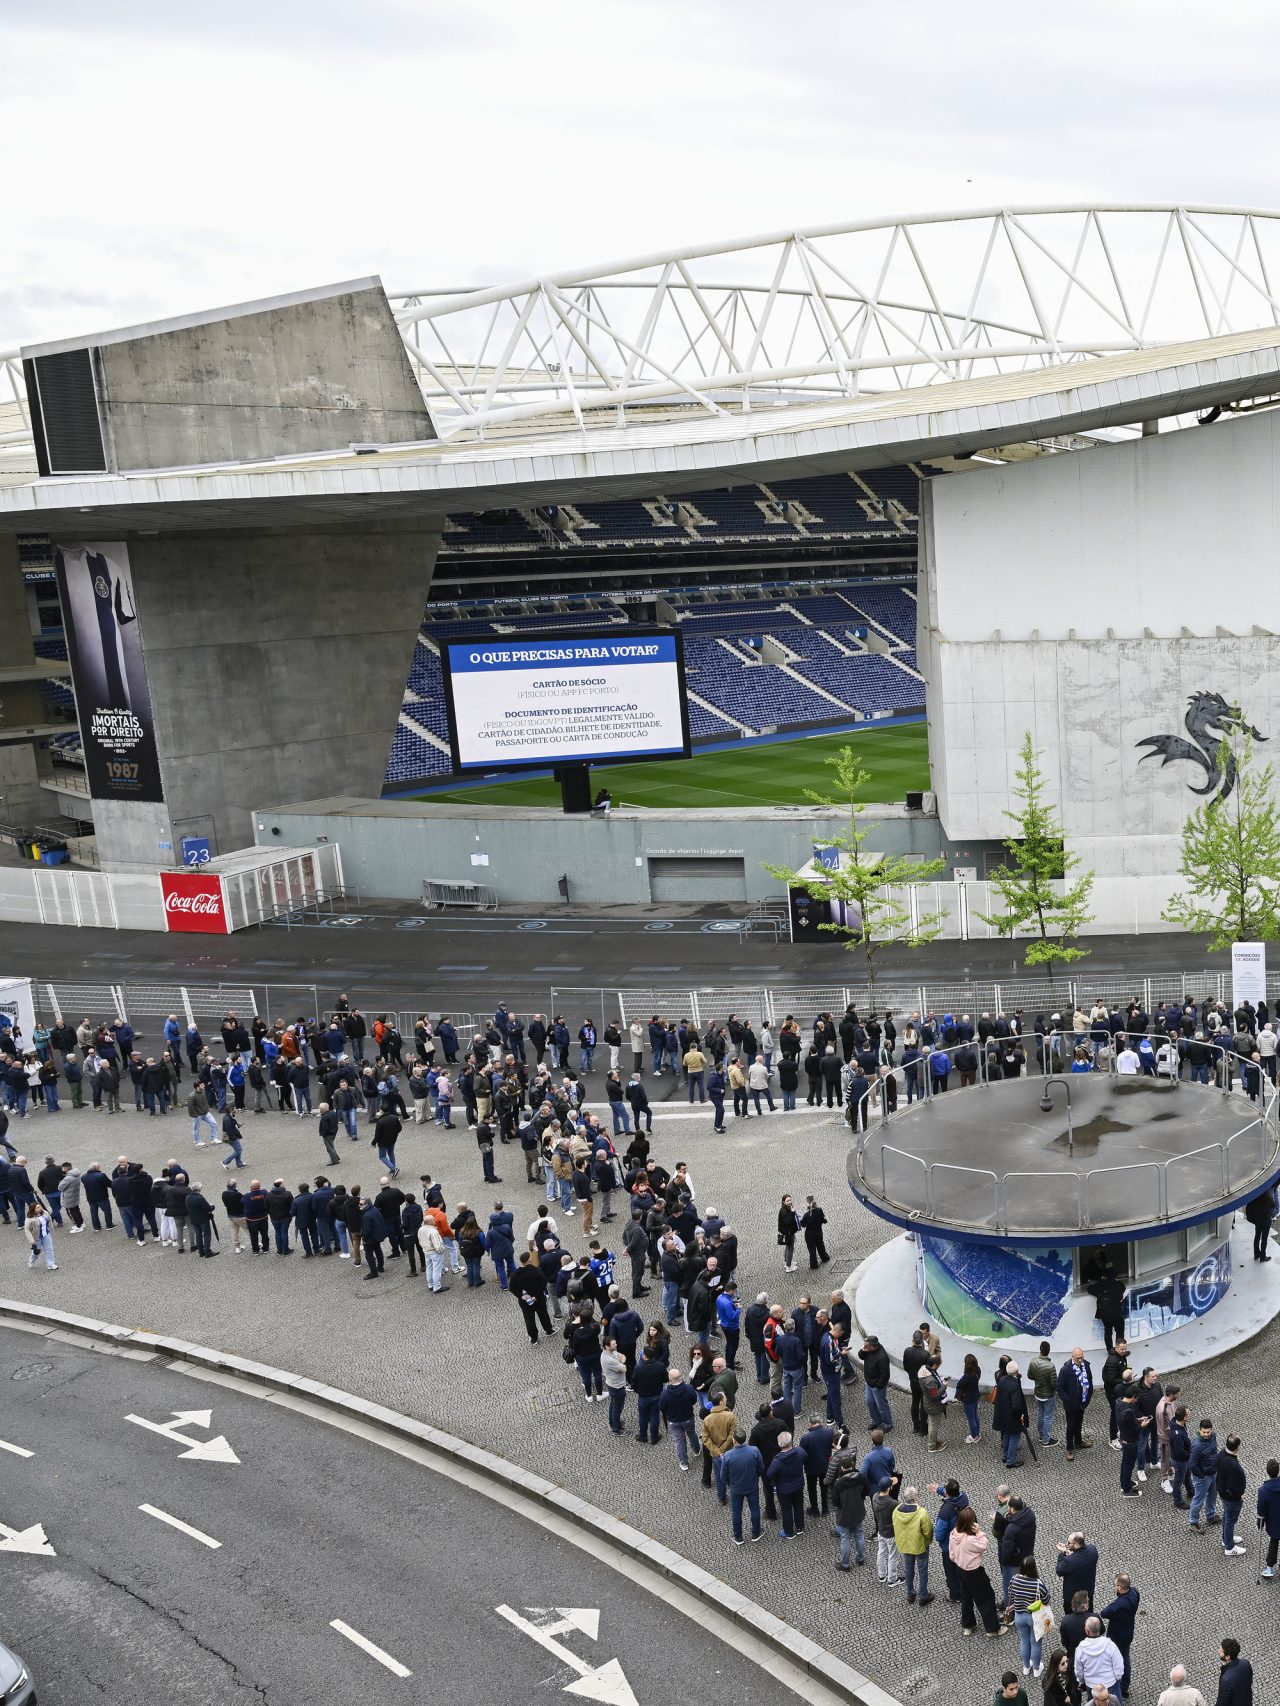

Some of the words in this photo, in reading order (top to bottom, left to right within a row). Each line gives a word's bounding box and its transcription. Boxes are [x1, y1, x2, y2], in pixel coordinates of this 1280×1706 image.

[470, 653, 480, 664] O
[482, 651, 510, 664] QUE
[512, 649, 573, 662] PRECISAS
[575, 648, 609, 660] PARA
[611, 645, 659, 658] VOTAR?
[533, 679, 567, 688] CARTÃO
[580, 678, 606, 686] SÓCIO
[518, 689, 546, 699] (FÍSICO
[547, 689, 560, 697] OU
[589, 686, 619, 695] PORTO)
[505, 708, 560, 719] DOCUMENTO
[573, 704, 638, 715] IDENTIFICAÇÃO
[568, 714, 622, 724] LEGALMENTE
[624, 711, 655, 720] VÁLIDO:
[92, 715, 140, 728] IMORTAIS
[110, 727, 144, 737] DIREITO
[478, 730, 512, 739] CARTÃO
[514, 729, 524, 737] DE
[526, 726, 564, 736] CIDADÃO,
[565, 724, 598, 733] BILHETE
[612, 721, 662, 730] IDENTIDADE,
[495, 737, 548, 747] PASSAPORTE
[563, 734, 590, 743] CARTA
[603, 730, 648, 740] CONDUÇÃO
[106, 762, 139, 778] 1987
[188, 848, 210, 865] 23
[824, 856, 839, 869] 24
[166, 891, 221, 914] Coca-Cola
[599, 1259, 614, 1276] 25
